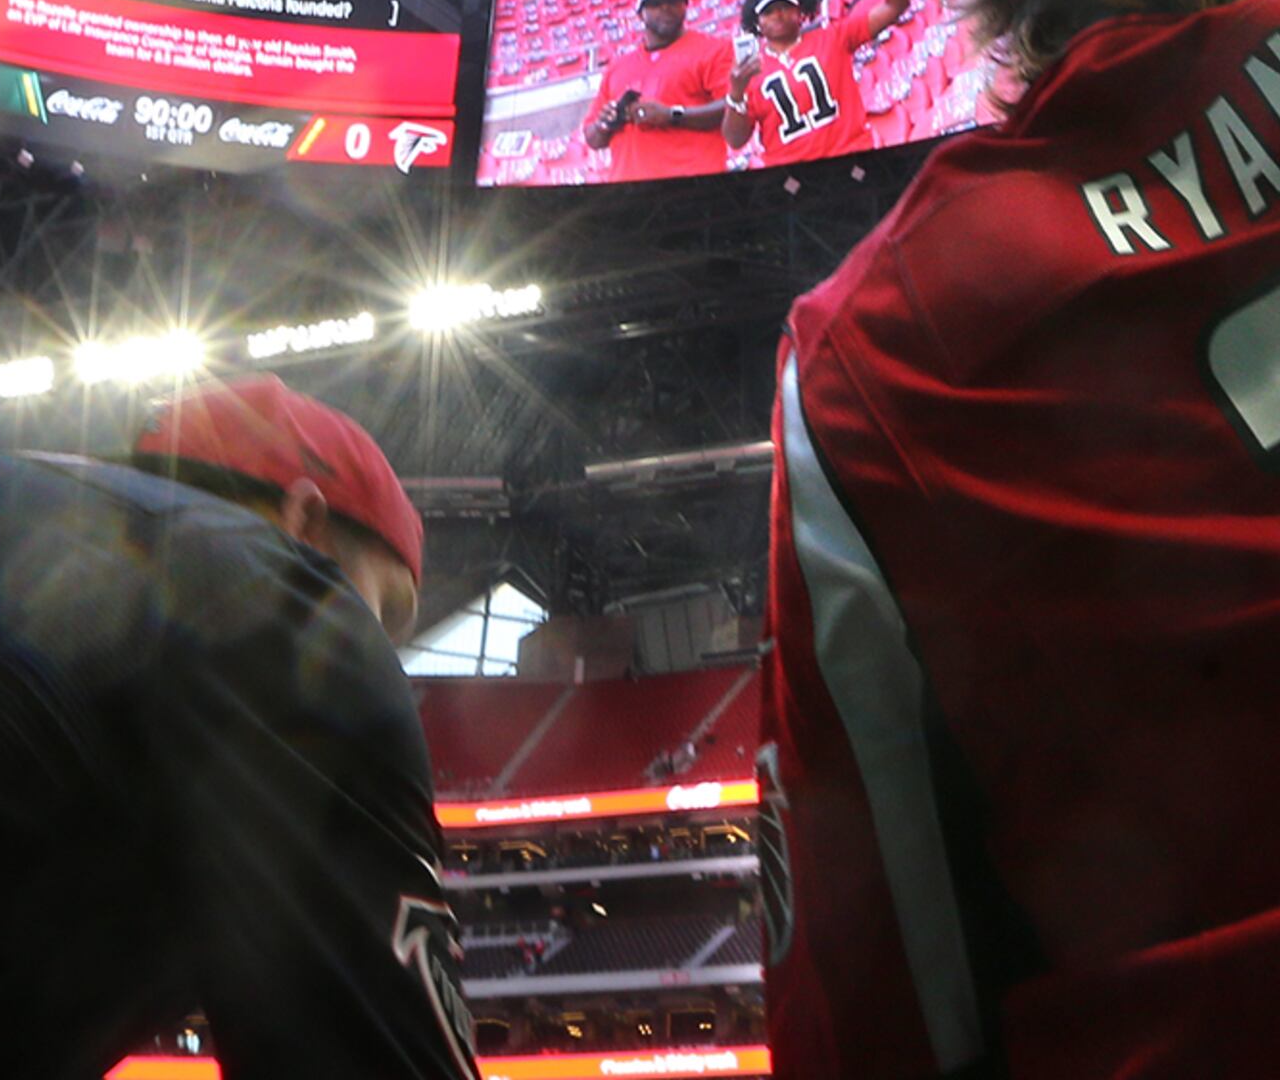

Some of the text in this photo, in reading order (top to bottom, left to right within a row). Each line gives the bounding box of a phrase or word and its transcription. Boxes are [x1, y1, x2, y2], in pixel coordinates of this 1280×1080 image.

[124, 19, 183, 41] ownership
[184, 28, 195, 42] to
[134, 96, 213, 133] 90:00
[761, 55, 838, 145] 11
[345, 123, 371, 159] 0
